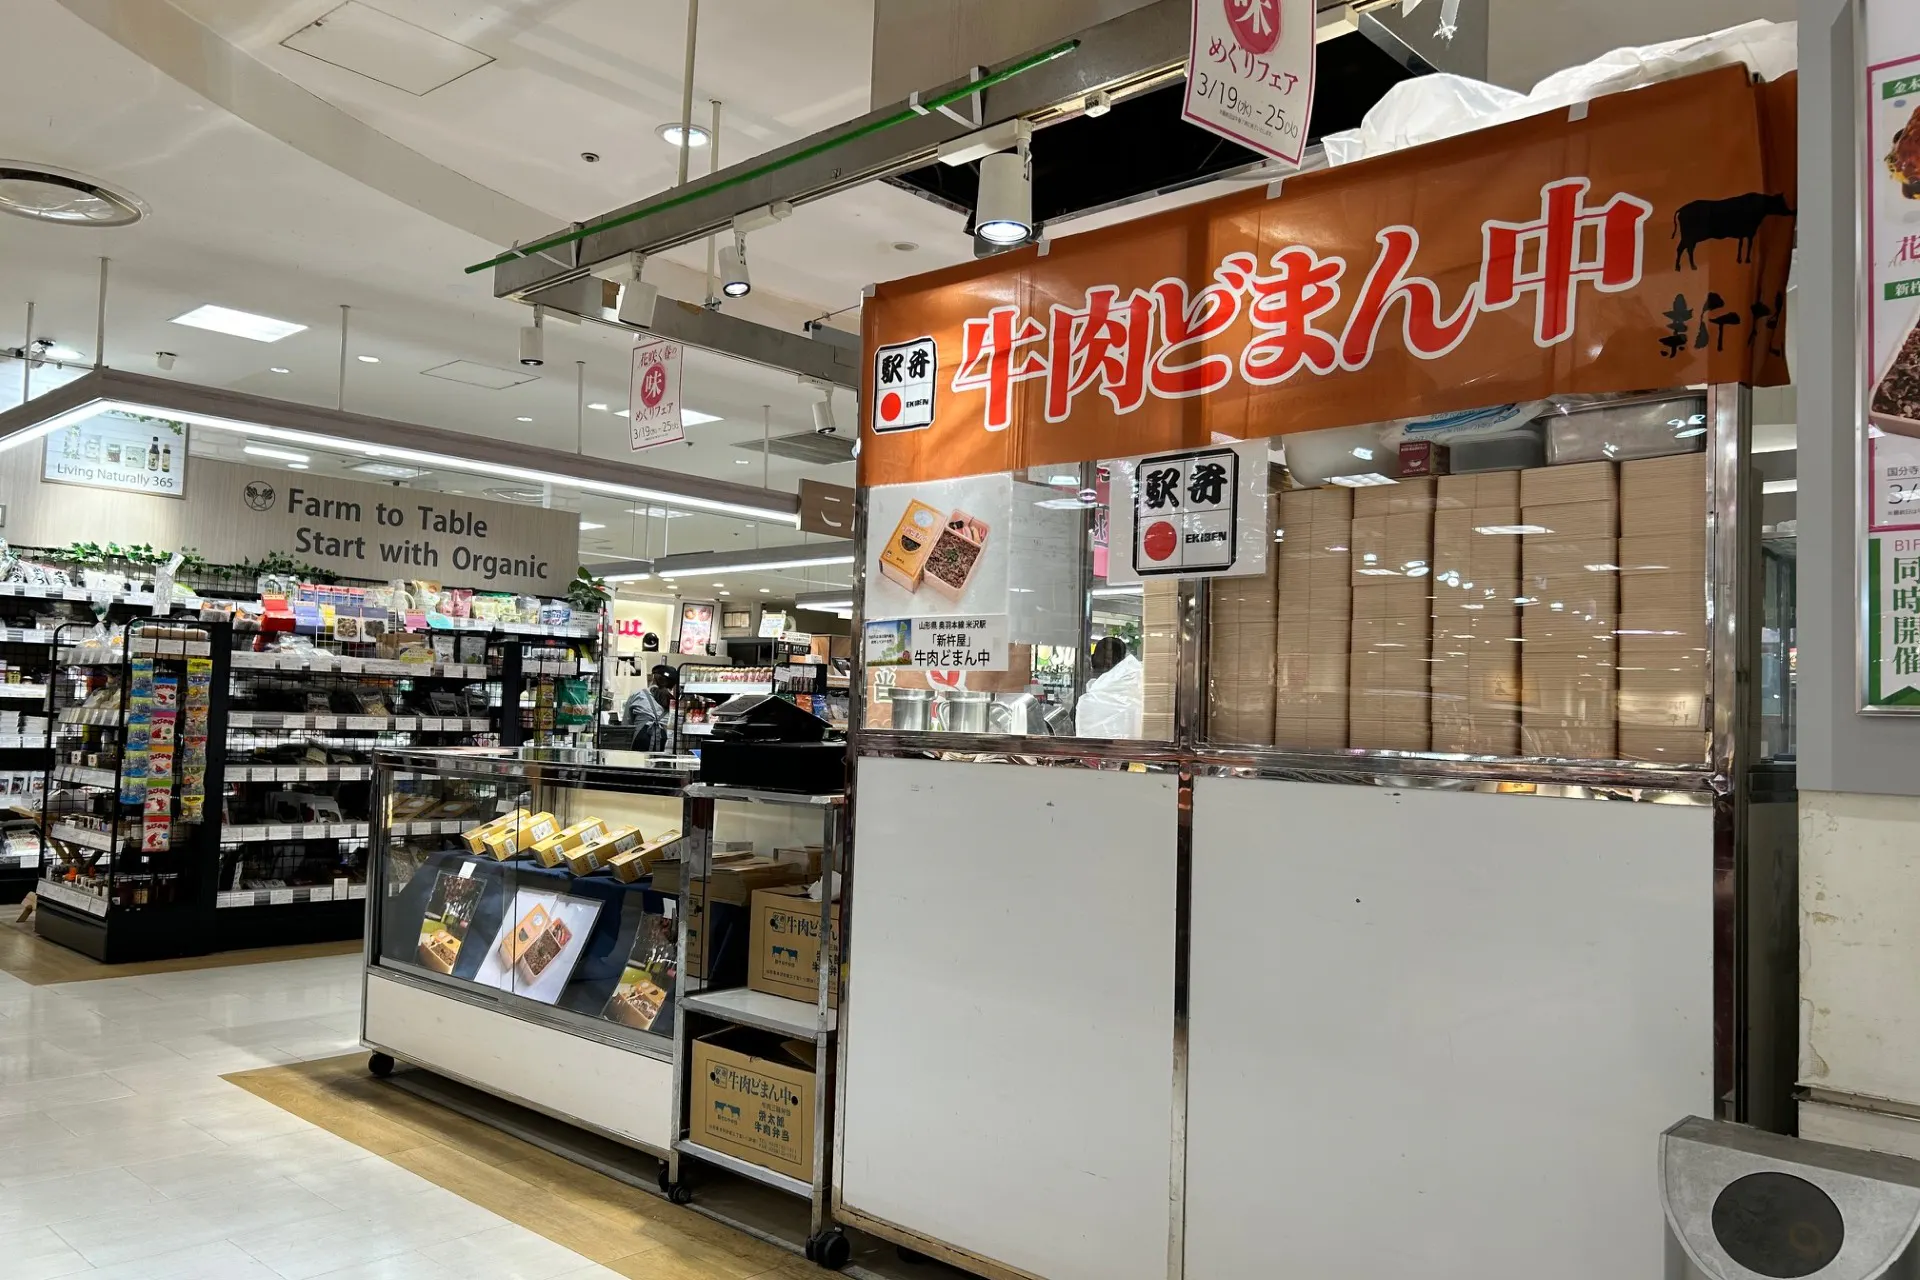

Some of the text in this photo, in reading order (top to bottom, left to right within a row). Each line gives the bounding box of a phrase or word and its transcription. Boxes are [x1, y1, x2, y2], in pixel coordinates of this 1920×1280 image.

[1208, 36, 1298, 95] めぐりフェア
[952, 176, 1653, 432] 牛肉どまん中
[881, 348, 931, 384] 駅弁
[645, 371, 662, 399] 味
[635, 402, 674, 422] めぐりフェア
[906, 398, 929, 408] EKIBEN
[57, 463, 173, 488] Living Naturally 365
[1144, 463, 1228, 509] 駅弁
[287, 487, 488, 538] Farm to Table
[1185, 531, 1227, 544] EKIBEN
[295, 527, 548, 580] Start with Organic
[919, 620, 986, 630] 山形県 奥羽本線 米沢駅
[914, 649, 990, 667] 牛肉どまん中
[728, 1070, 792, 1105] 牛肉どまん中
